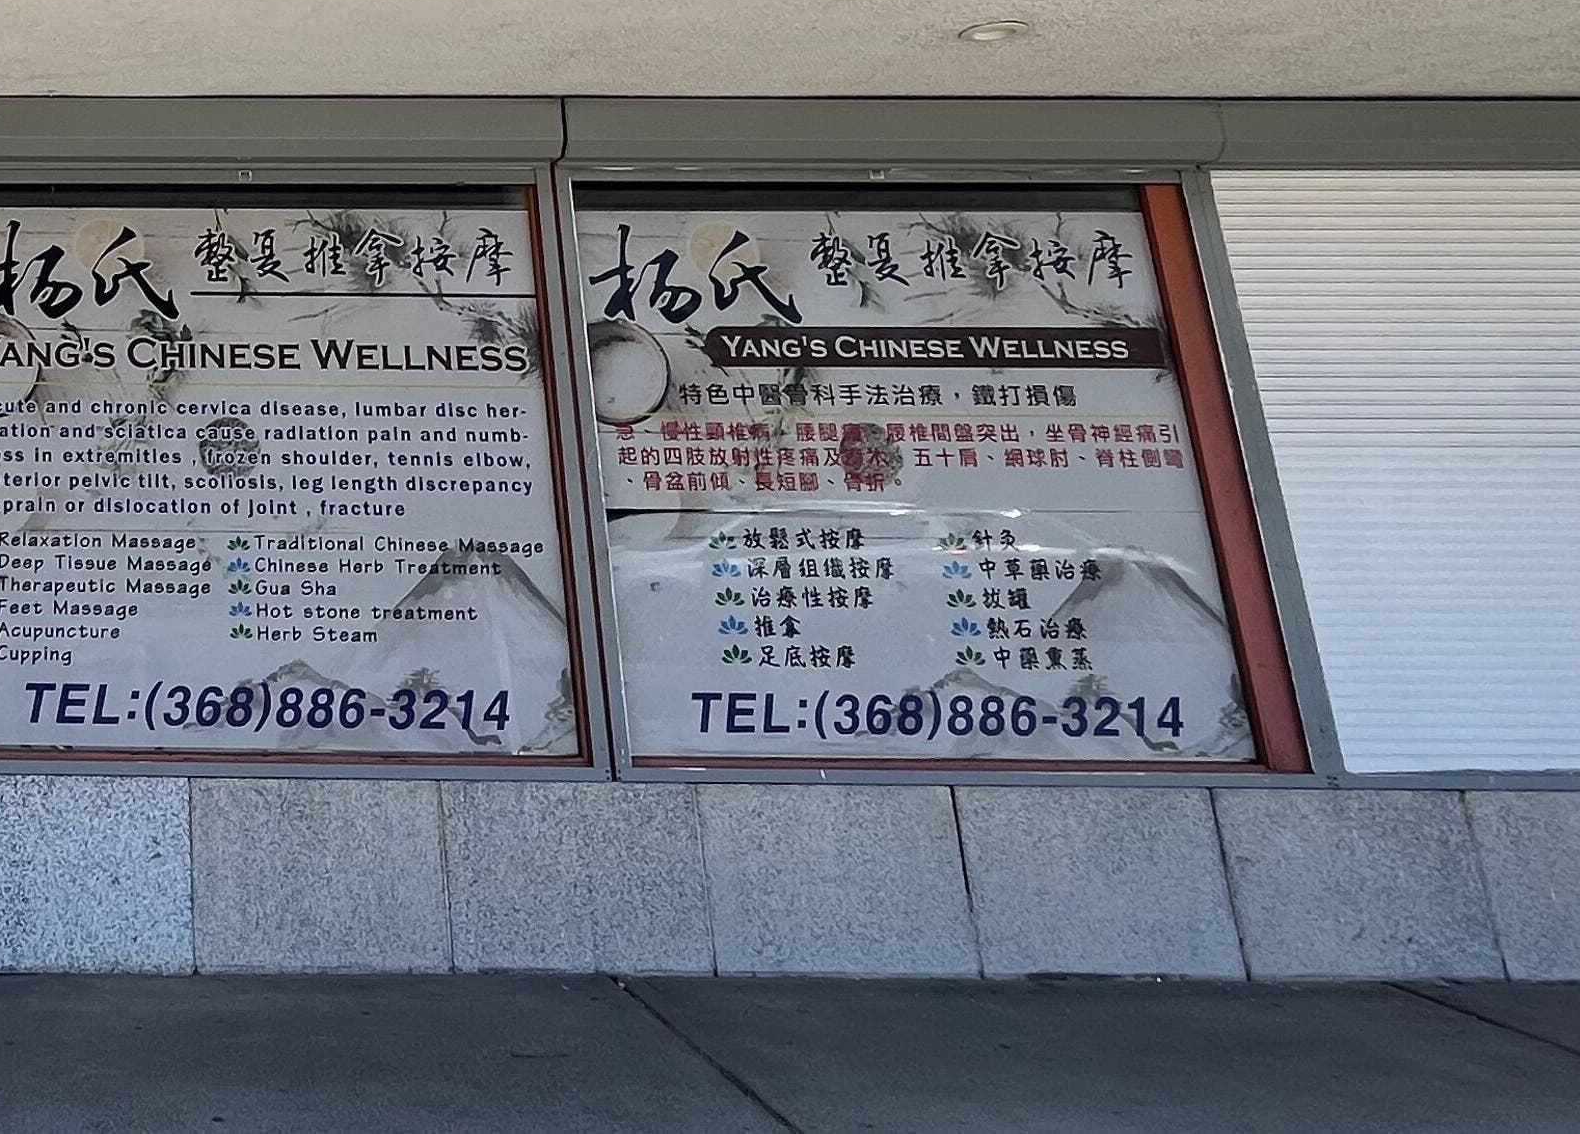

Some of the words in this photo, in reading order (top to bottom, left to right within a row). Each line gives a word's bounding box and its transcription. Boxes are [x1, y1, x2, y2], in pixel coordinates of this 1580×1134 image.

[128, 337, 301, 369] CHINESE
[311, 339, 527, 371] WELLNESS
[722, 335, 828, 358] YANG'S
[835, 335, 964, 359] CHINESE
[968, 336, 1129, 359] WELLNESS
[46, 399, 81, 414] and
[91, 400, 167, 415] chronic
[177, 401, 251, 415] cervica
[261, 401, 346, 419] disease,
[355, 402, 426, 417] lumbar
[436, 403, 477, 417] disc
[487, 404, 526, 418] her-
[60, 424, 95, 438] and
[104, 424, 187, 439] sciatica
[196, 427, 255, 440] cause
[265, 426, 358, 441] radiation
[368, 427, 411, 444] pain
[420, 428, 457, 442] and
[466, 428, 528, 443] numb-
[34, 447, 52, 462] in
[63, 448, 182, 464] extremities
[207, 449, 271, 465] frozen
[281, 450, 378, 468] shoulder,
[388, 451, 454, 466] tennis
[464, 452, 531, 470] elbow,
[69, 473, 130, 490] pelvic
[139, 473, 176, 491] tilt,
[184, 474, 284, 492] scoliosis,
[292, 476, 324, 493] leg
[331, 476, 397, 495] length
[406, 477, 533, 496] discrepancy
[65, 501, 85, 513] or
[94, 498, 211, 514] dislocation
[220, 499, 240, 514] of
[247, 499, 297, 518] joint
[320, 500, 405, 516] fracture
[111, 533, 196, 553] Massage
[254, 535, 364, 552] Traditional
[374, 536, 448, 553] Chinese
[458, 538, 544, 557] Massage
[742, 527, 864, 550] 放鬆式按摩
[972, 529, 1019, 551] 針灸
[55, 554, 117, 570] Tissue
[127, 556, 212, 575] Massage
[254, 557, 328, 574] Chinese
[339, 558, 384, 574] Herb
[395, 559, 502, 575] Treatment
[126, 578, 211, 598] Massage
[255, 581, 290, 596] Gua
[301, 581, 337, 596] Sha
[751, 585, 873, 609] 治療性按摩
[53, 600, 138, 620] Massage
[256, 604, 293, 619] Hot
[303, 605, 360, 619] stone
[371, 605, 478, 621] treatment
[257, 626, 302, 641] Herb
[312, 626, 378, 642] Steam
[754, 615, 801, 637] 推拿
[986, 616, 1087, 640] 熱石治療
[758, 644, 856, 668] 足底按摩
[24, 681, 510, 732] TEL:(368)886-3214
[691, 690, 1185, 741] TEL:(368)886-3214
